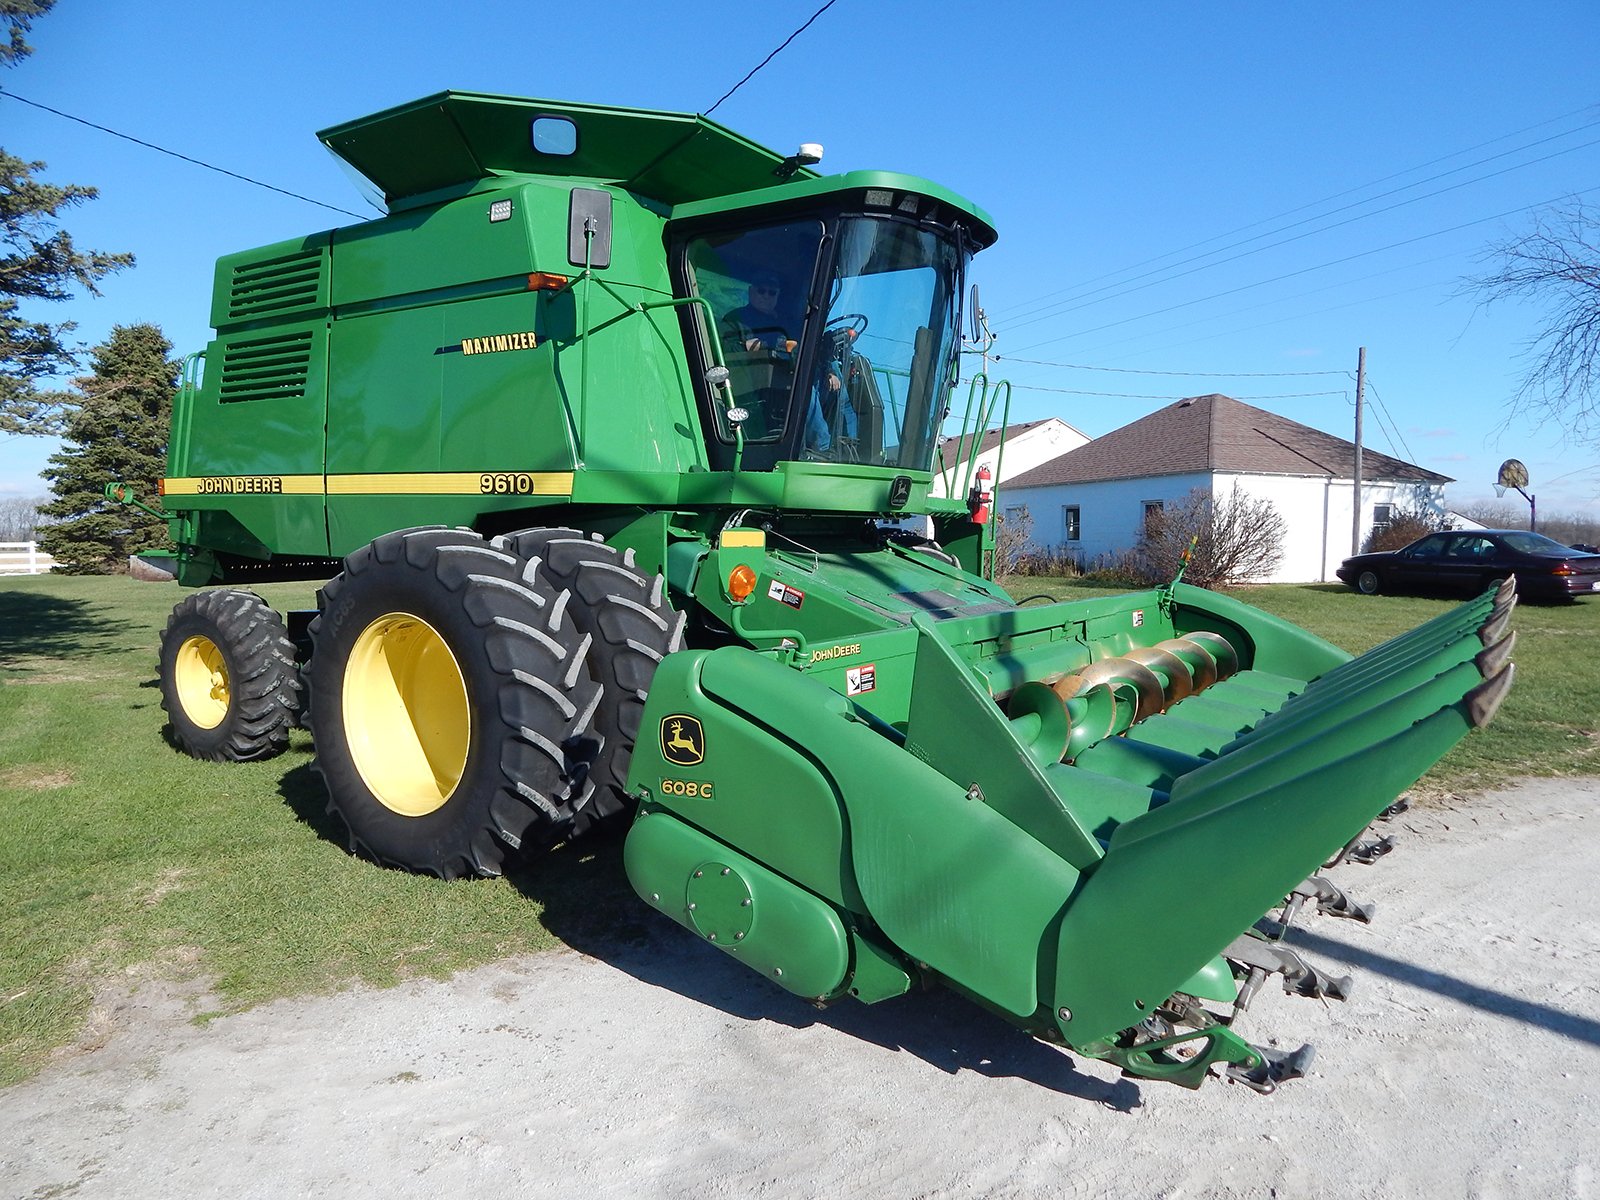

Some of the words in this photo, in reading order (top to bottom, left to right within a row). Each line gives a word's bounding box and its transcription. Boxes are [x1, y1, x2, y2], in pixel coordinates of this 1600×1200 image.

[461, 331, 537, 355] MAXIMIZER
[197, 478, 234, 493] JOHN
[235, 477, 282, 493] DEERE
[480, 474, 534, 494] 9610
[810, 650, 833, 663] JOHN
[833, 643, 861, 658] DEERE
